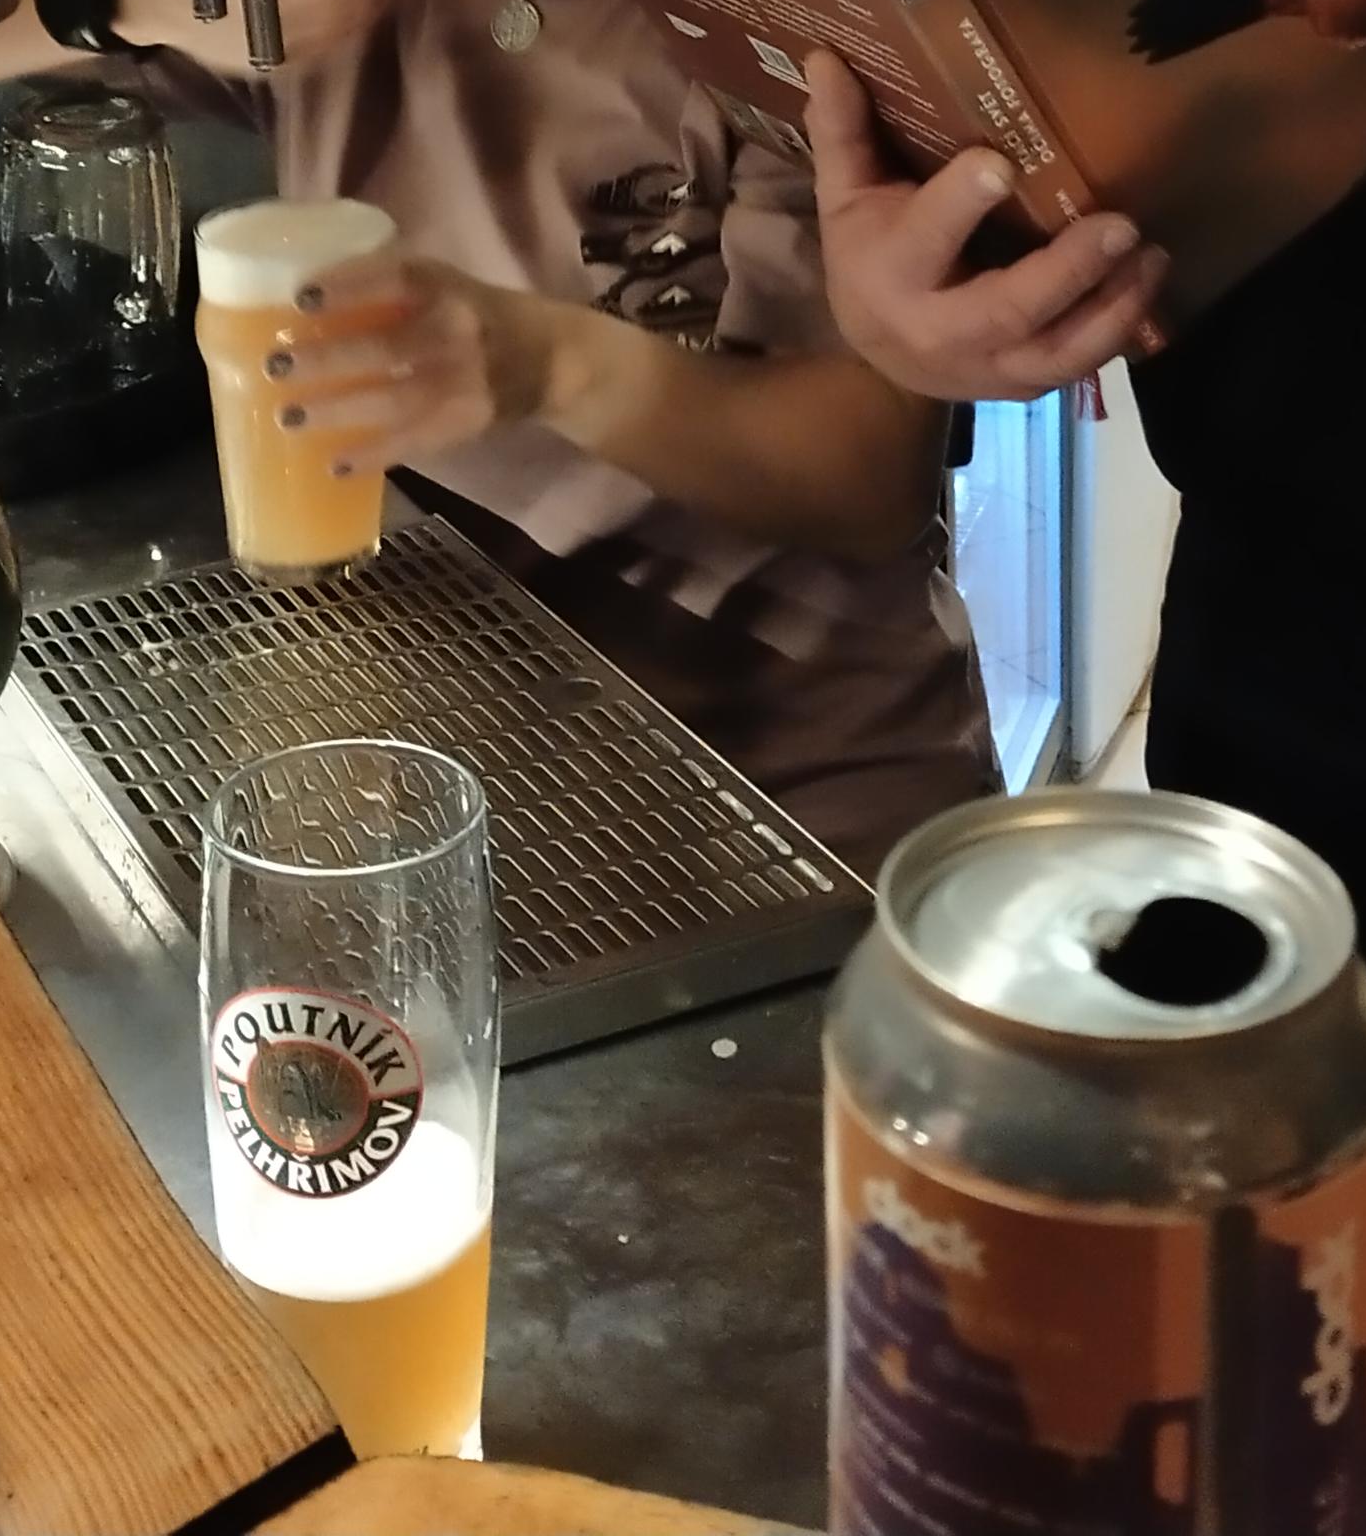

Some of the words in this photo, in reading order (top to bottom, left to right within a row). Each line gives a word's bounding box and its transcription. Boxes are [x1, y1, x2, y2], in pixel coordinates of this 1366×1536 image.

[958, 16, 1020, 109] FOTOGRAFA
[977, 91, 1009, 128] SVĚT
[221, 1001, 407, 1086] POUTNÍK
[218, 1078, 414, 1193] PELHŘIMOV
